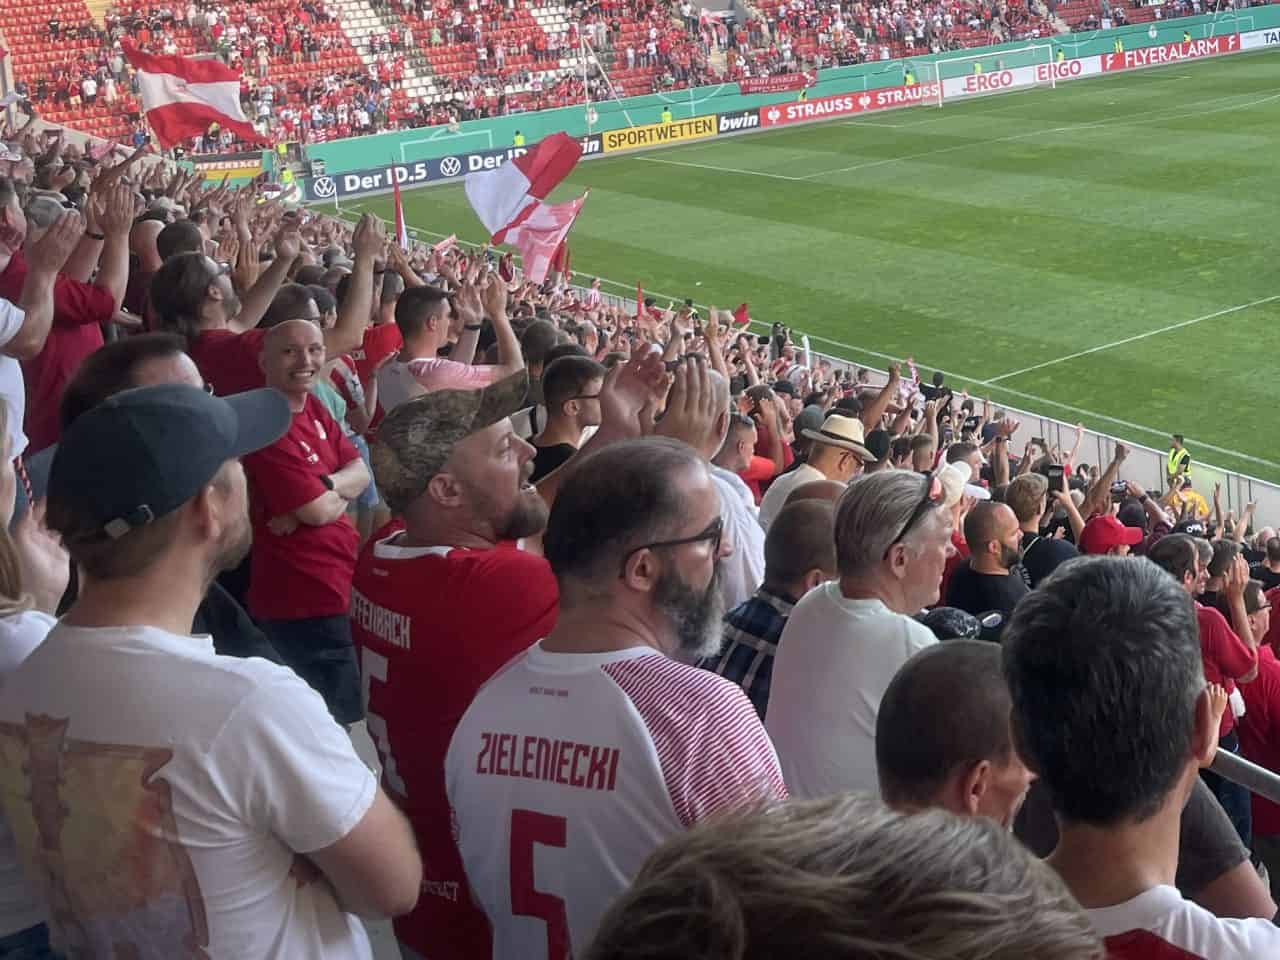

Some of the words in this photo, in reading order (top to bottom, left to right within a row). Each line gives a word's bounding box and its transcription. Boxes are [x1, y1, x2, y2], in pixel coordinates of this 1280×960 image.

[1124, 40, 1220, 68] FLYERALARM
[965, 71, 1013, 91] ERGO
[1037, 60, 1082, 81] ERGO
[877, 83, 939, 105] STRAUSS
[786, 98, 853, 119] STRAUSS
[608, 119, 713, 148] SPORTWETTEN
[719, 112, 759, 132] bwin
[468, 152, 503, 171] Der
[344, 174, 382, 192] Der
[386, 163, 427, 184] ID.5
[351, 587, 410, 649] FFENBACH
[476, 732, 621, 792] ZIELENIECKI
[510, 808, 572, 960] 5
